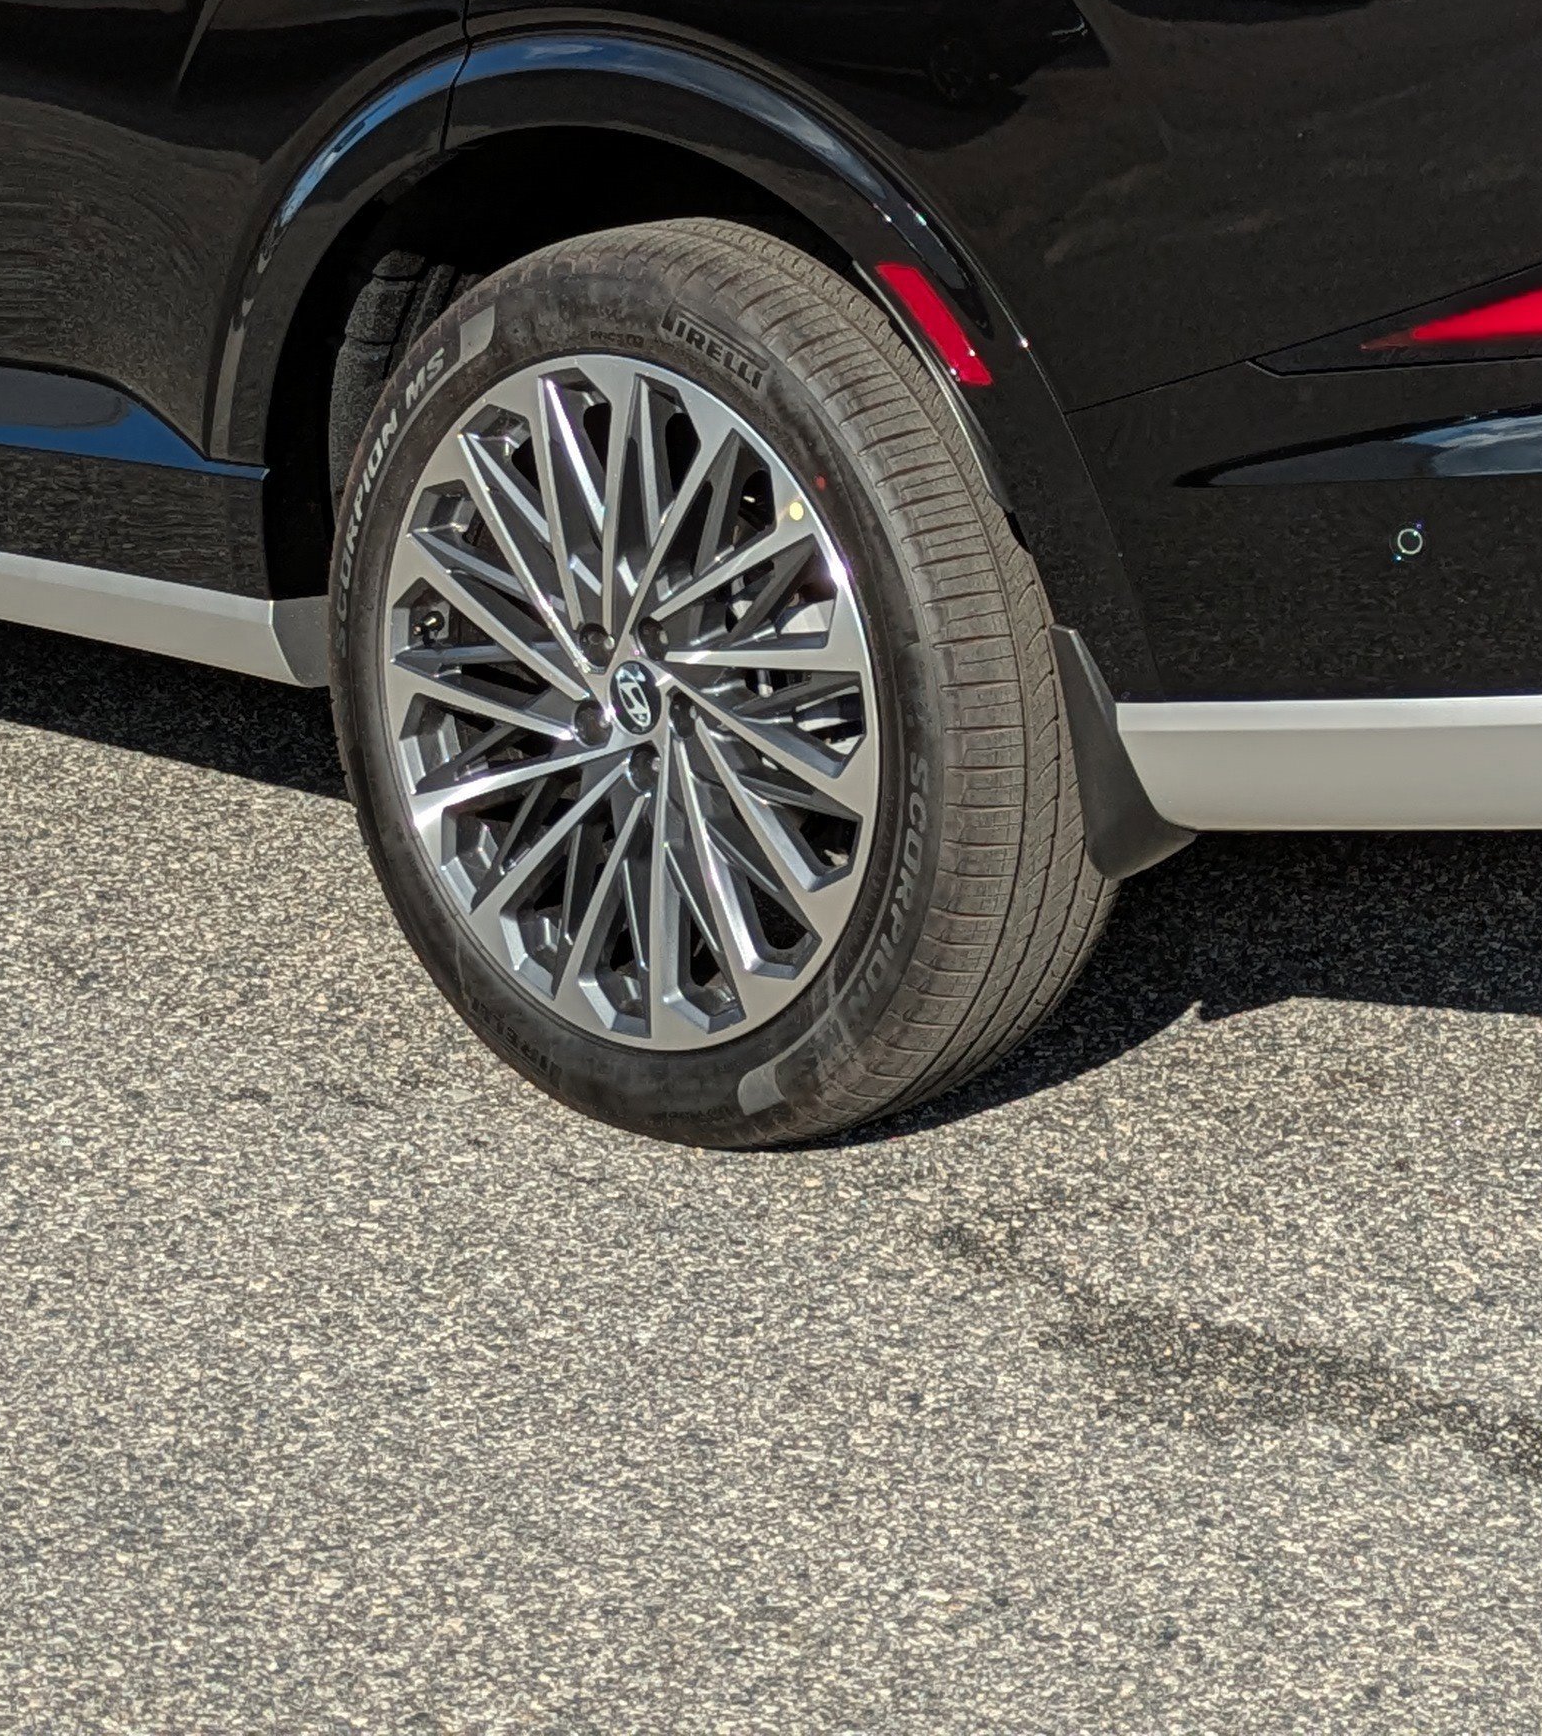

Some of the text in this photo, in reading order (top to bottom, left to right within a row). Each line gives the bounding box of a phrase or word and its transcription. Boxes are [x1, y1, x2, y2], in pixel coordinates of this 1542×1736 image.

[661, 301, 770, 390] PIRELLI
[335, 347, 445, 658] SCORPION MS
